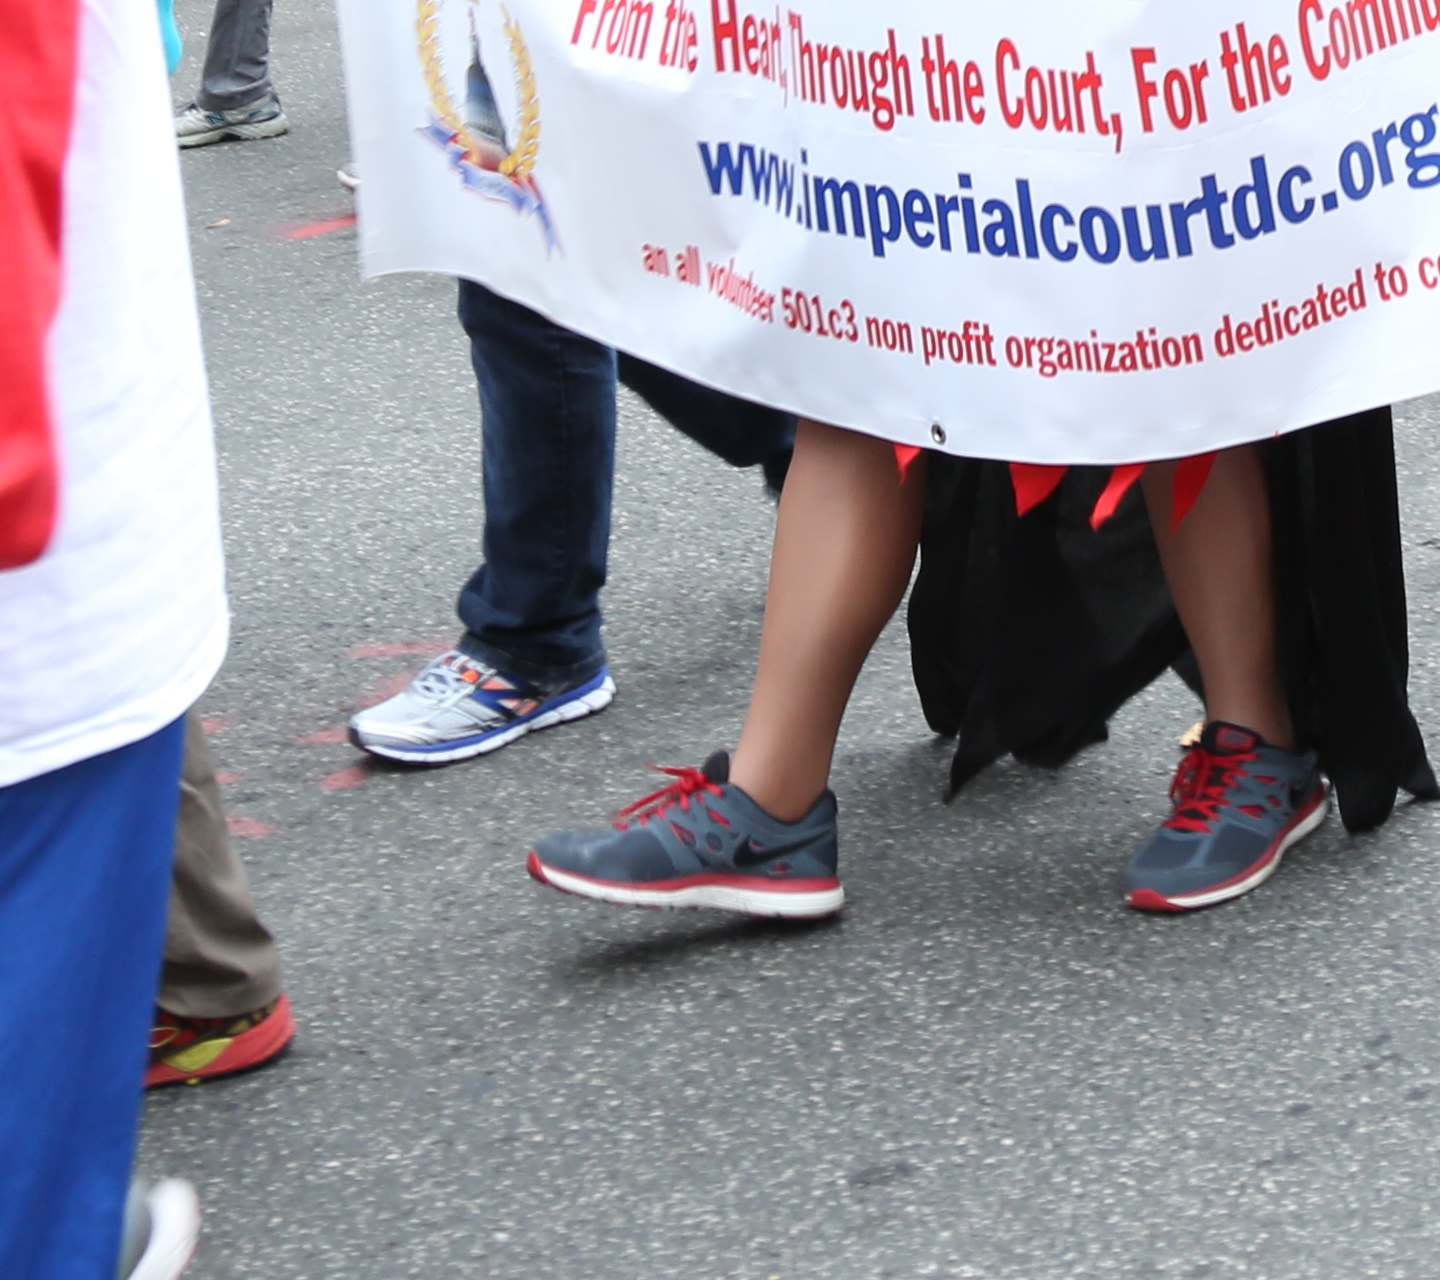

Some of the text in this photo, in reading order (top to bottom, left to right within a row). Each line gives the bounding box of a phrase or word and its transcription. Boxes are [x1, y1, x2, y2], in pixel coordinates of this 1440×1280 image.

[788, 8, 914, 131] Through
[921, 36, 986, 125] the
[995, 37, 1123, 154] Court,
[1130, 47, 1209, 134] For
[1220, 22, 1292, 114] the
[641, 243, 670, 277] an
[676, 244, 701, 287] all
[706, 257, 777, 324] volunteer
[781, 287, 859, 343] 501c3
[865, 315, 913, 354] non
[921, 320, 997, 367] profit
[1005, 328, 1204, 378] organization
[1213, 267, 1368, 359] dedicated
[1375, 262, 1408, 302] to
